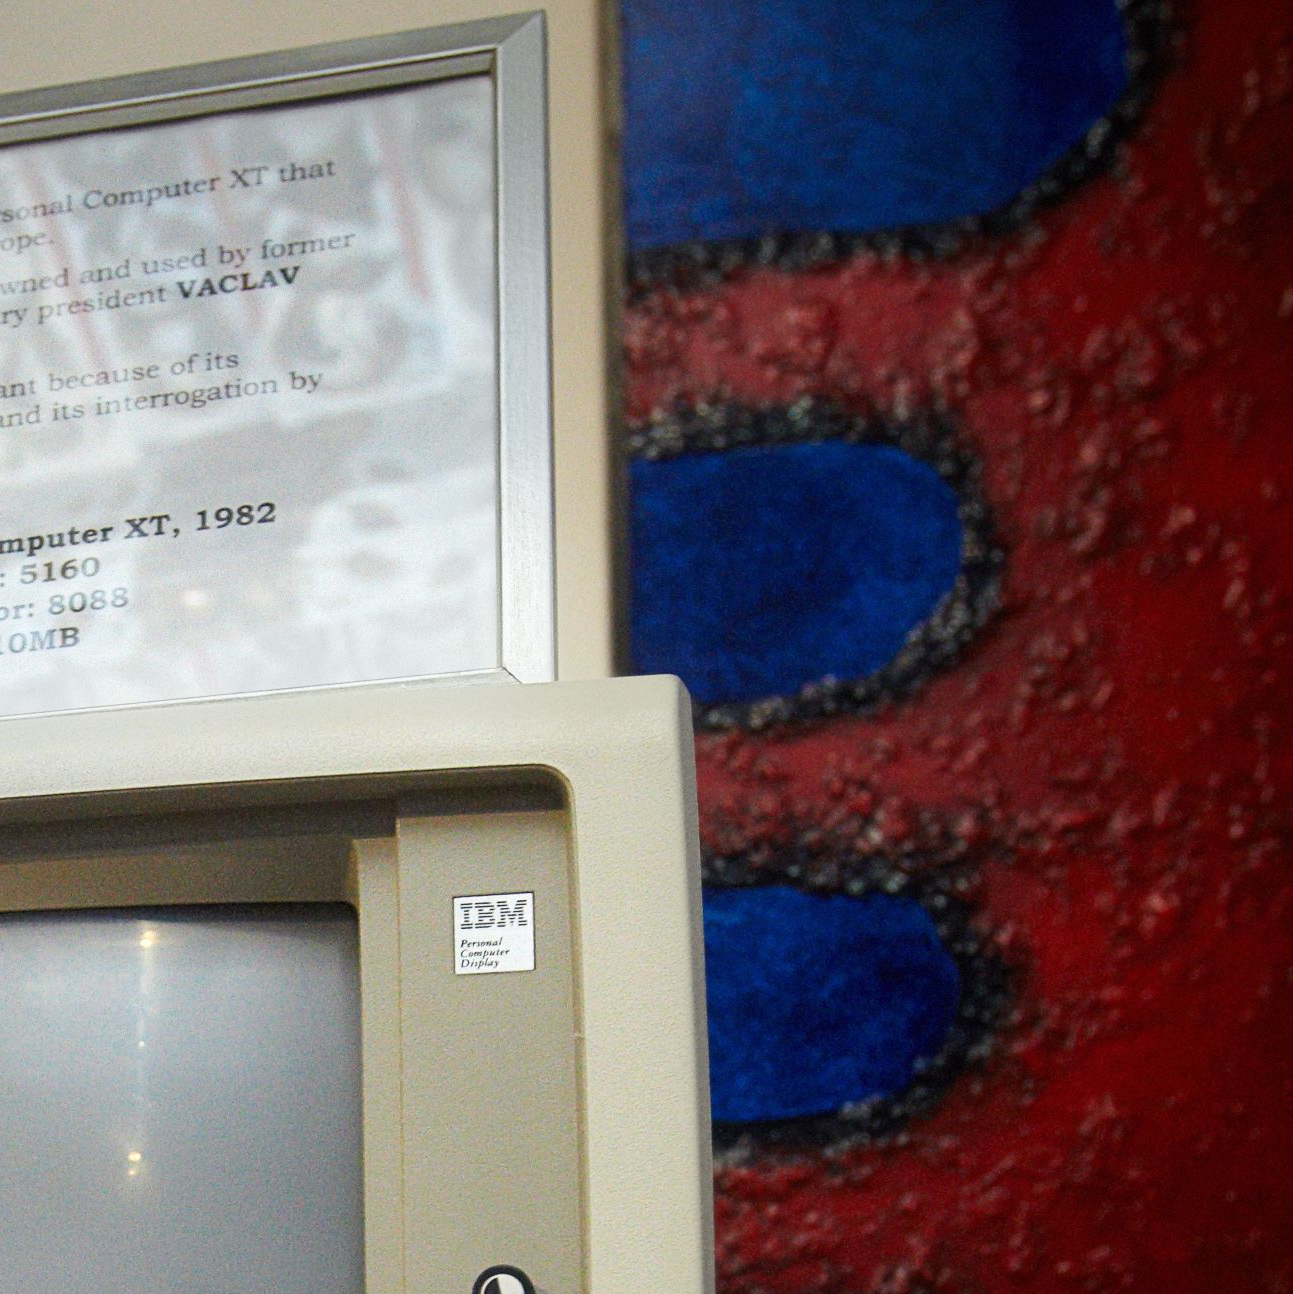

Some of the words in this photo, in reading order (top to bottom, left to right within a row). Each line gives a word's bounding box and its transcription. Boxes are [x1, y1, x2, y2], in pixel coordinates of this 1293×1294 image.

[82, 176, 222, 212] Computer
[228, 166, 269, 191] XT
[277, 160, 336, 183] that
[80, 260, 132, 285] and
[141, 248, 207, 276] used
[217, 244, 252, 270] by
[260, 233, 355, 261] former
[37, 285, 168, 325] president
[176, 265, 303, 300] VACLAV
[47, 365, 161, 393] because
[170, 353, 202, 376] of
[205, 352, 240, 373] its
[52, 400, 86, 422] its
[95, 378, 278, 416] interrogation
[287, 370, 324, 394] by
[123, 513, 181, 540] XT,
[195, 501, 277, 532] 1982
[19, 556, 101, 586] 5160
[47, 586, 130, 617] 8088
[460, 900, 527, 929] IBM
[460, 937, 503, 947] Personal
[460, 948, 511, 959] Computer
[461, 959, 499, 969] Display
